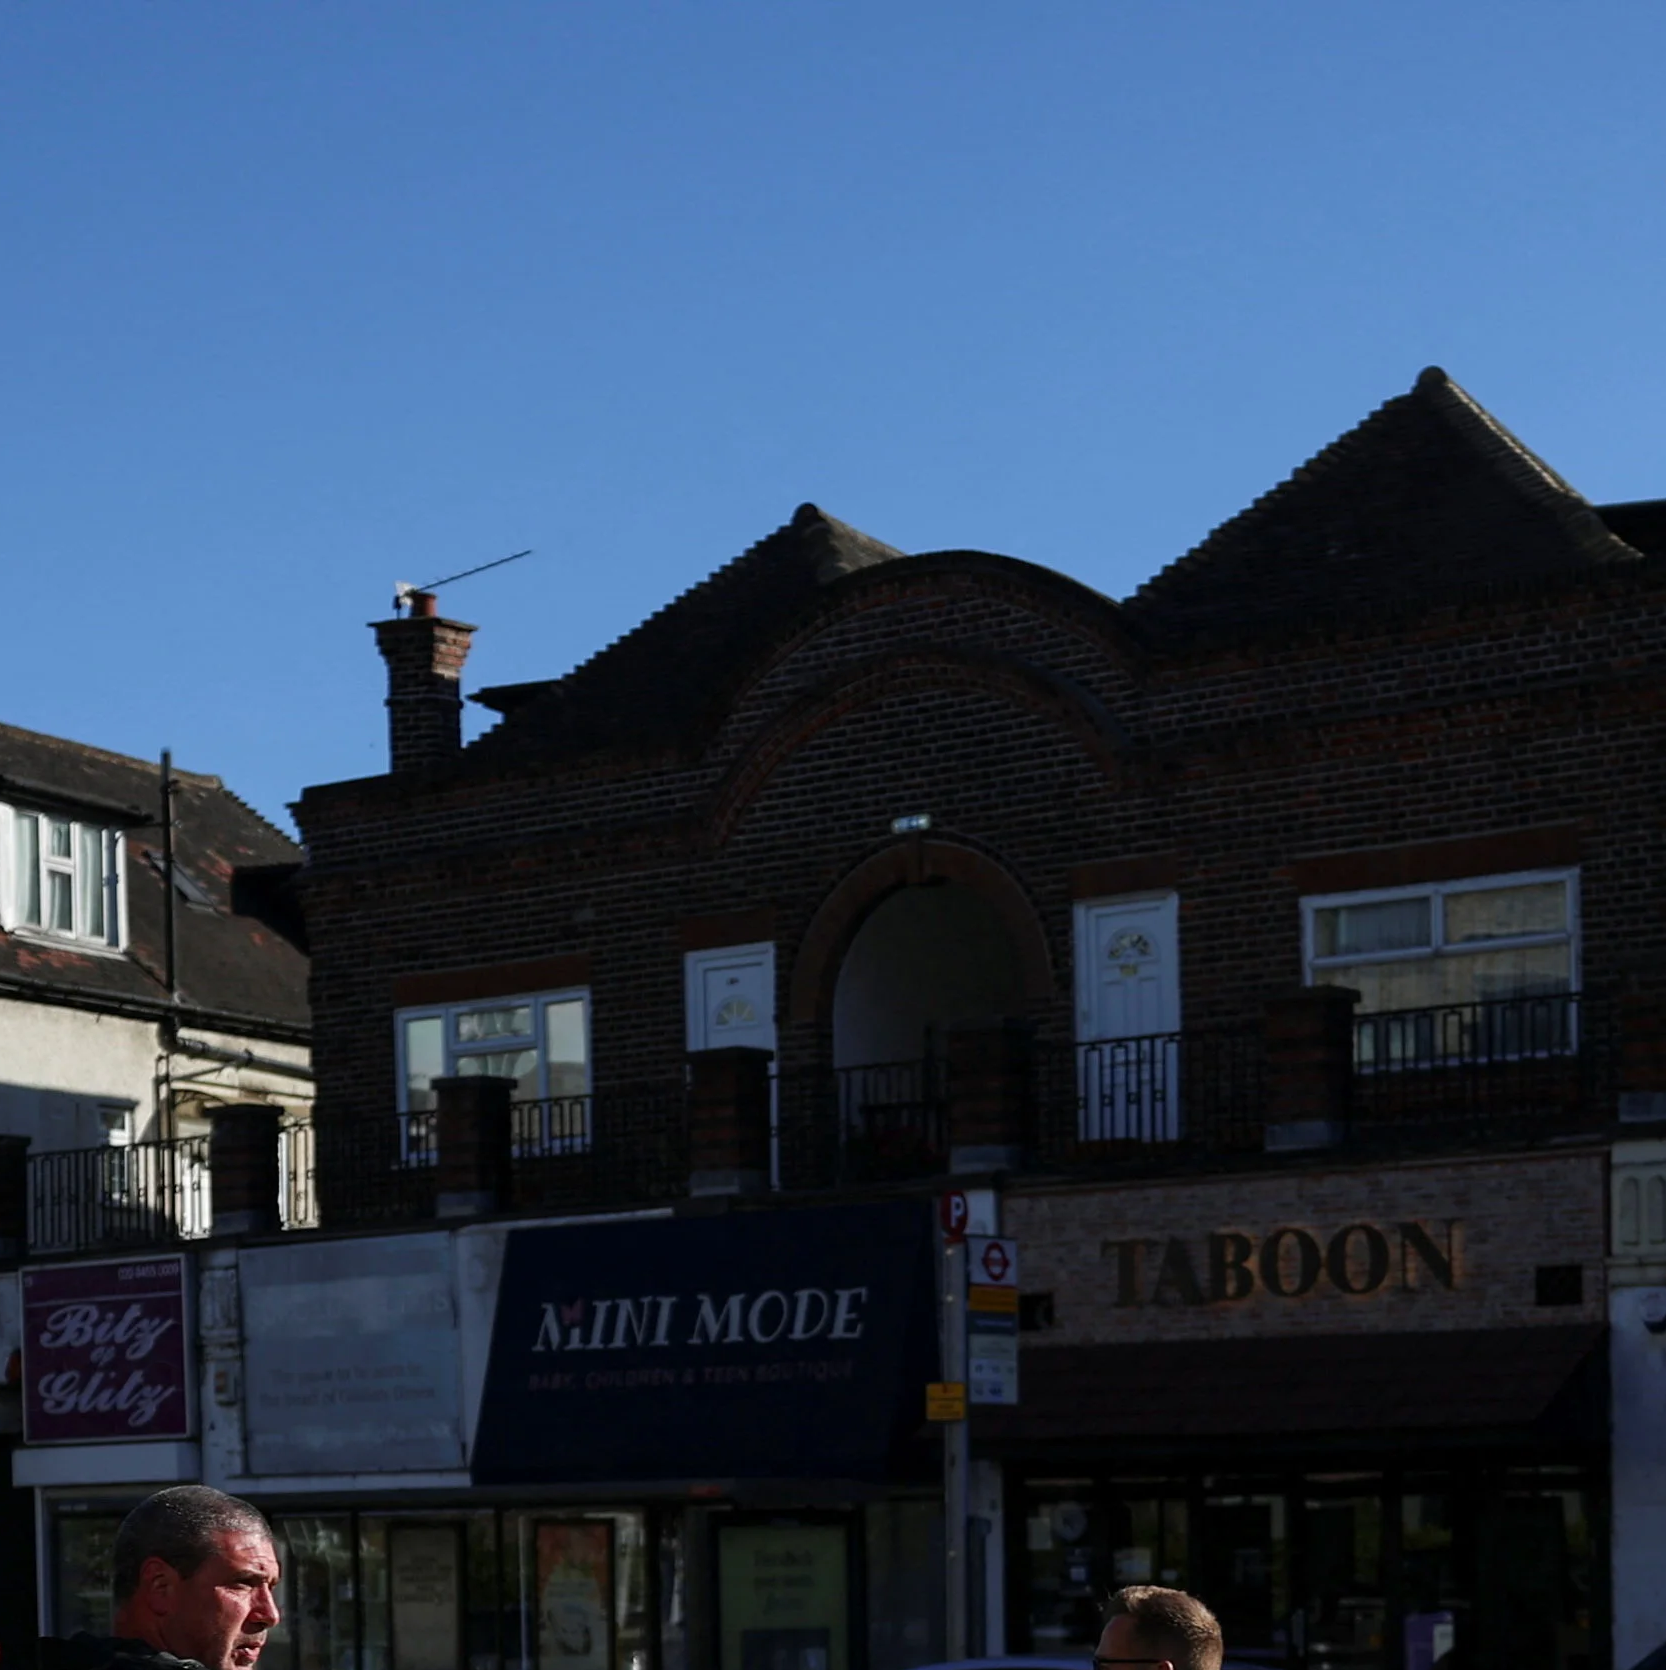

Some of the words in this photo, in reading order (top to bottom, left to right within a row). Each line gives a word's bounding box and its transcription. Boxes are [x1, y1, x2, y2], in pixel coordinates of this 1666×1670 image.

[1099, 1218, 1467, 1308] TABOON
[39, 1303, 175, 1361] Bitz
[531, 1296, 680, 1352] MINI
[686, 1286, 868, 1345] MODE
[37, 1369, 176, 1428] Glitz
